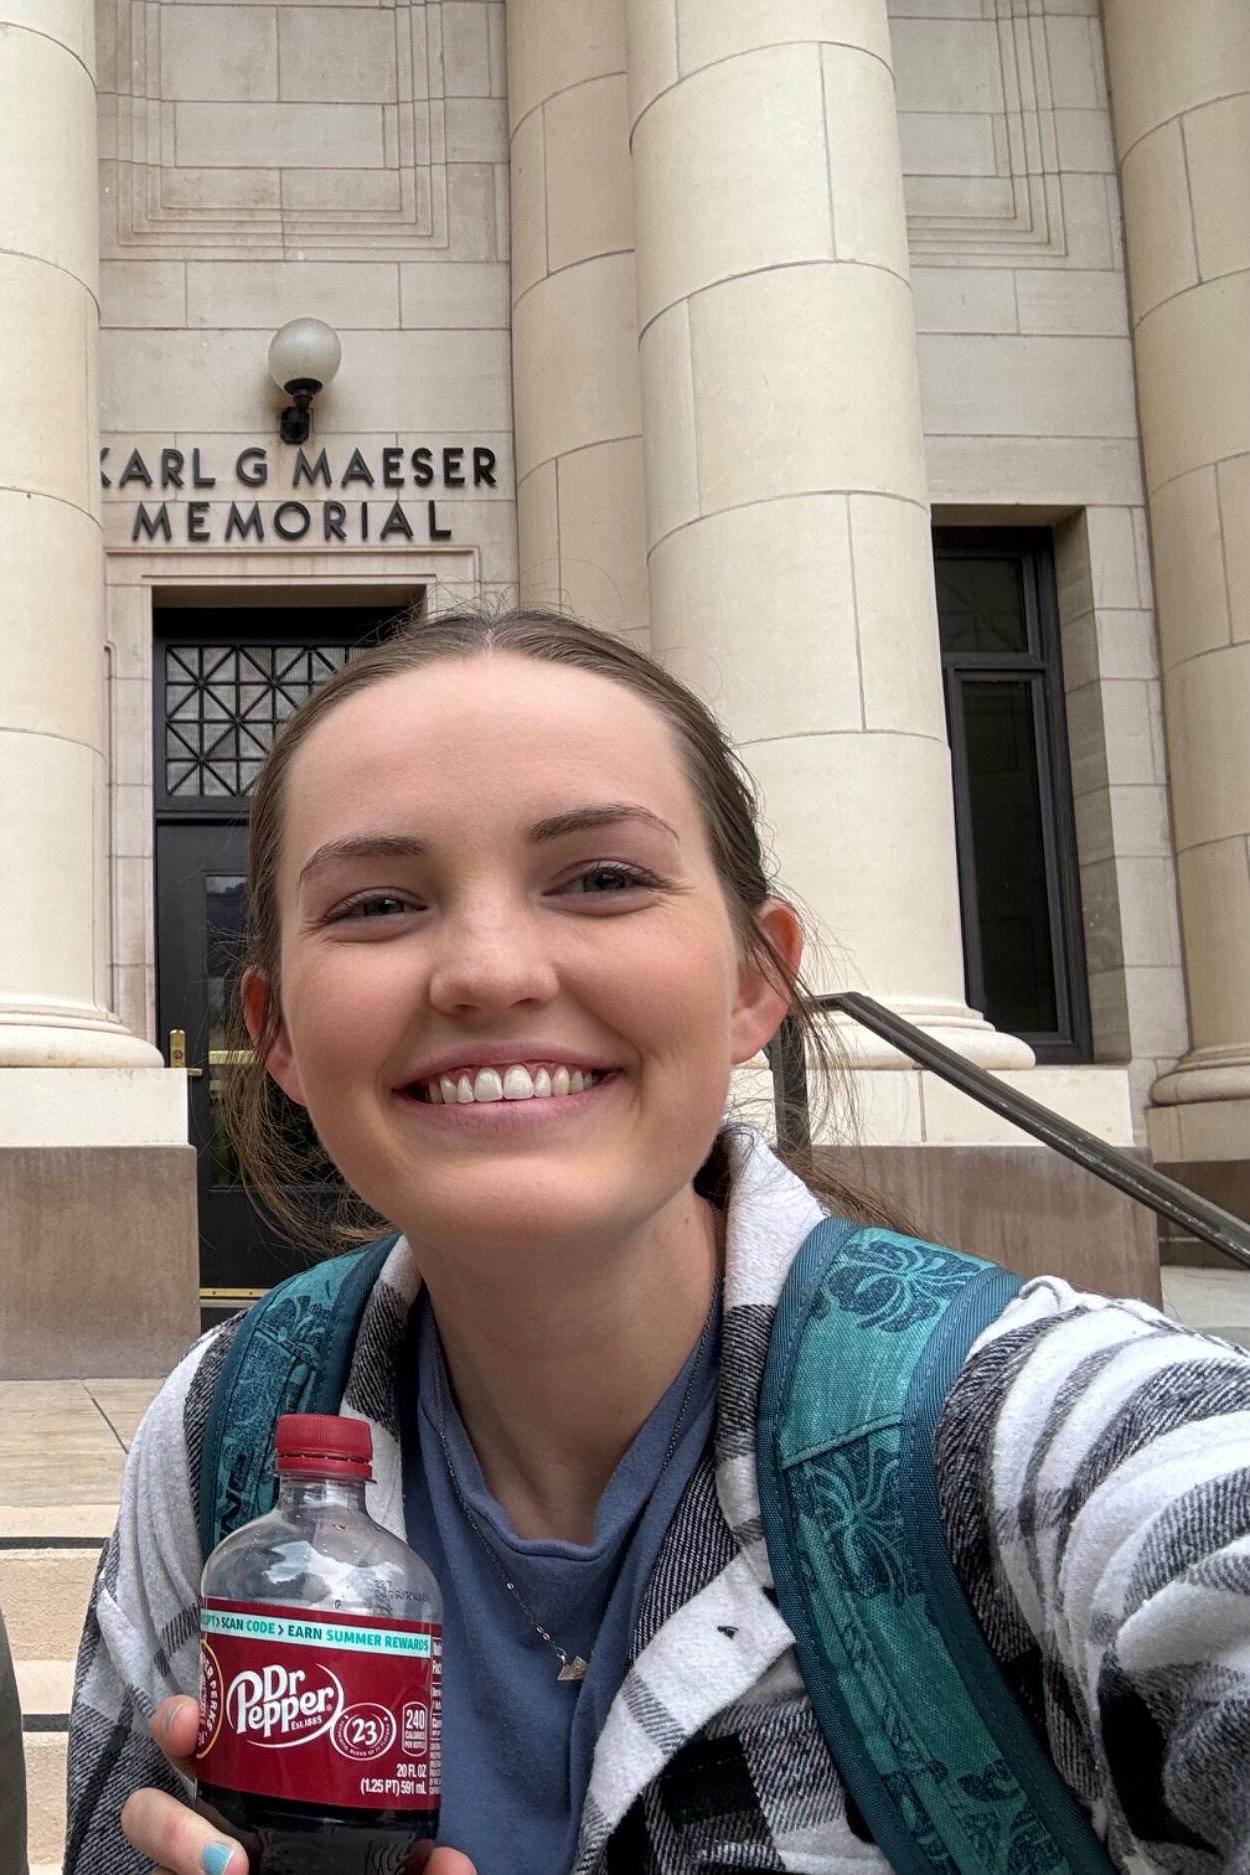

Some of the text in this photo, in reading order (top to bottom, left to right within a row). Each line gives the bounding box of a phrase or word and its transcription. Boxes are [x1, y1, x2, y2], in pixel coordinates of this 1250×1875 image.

[236, 447, 268, 487] G
[292, 446, 498, 488] MAESER
[132, 500, 452, 542] MEMORIAL
[221, 1616, 244, 1631] SCAN
[246, 1620, 275, 1635] CODE
[287, 1625, 322, 1640] EARN
[325, 1629, 382, 1647] SUMMER
[384, 1635, 429, 1652] REWARDS
[262, 1664, 306, 1703] Dr
[226, 1670, 335, 1738] Pepper
[406, 1709, 425, 1730] 240
[352, 1717, 378, 1746] 23
[360, 1777, 384, 1796] (1.25
[385, 1779, 400, 1797] PT)
[400, 1780, 415, 1795] 591
[396, 1763, 427, 1778] 20 FL OZ
